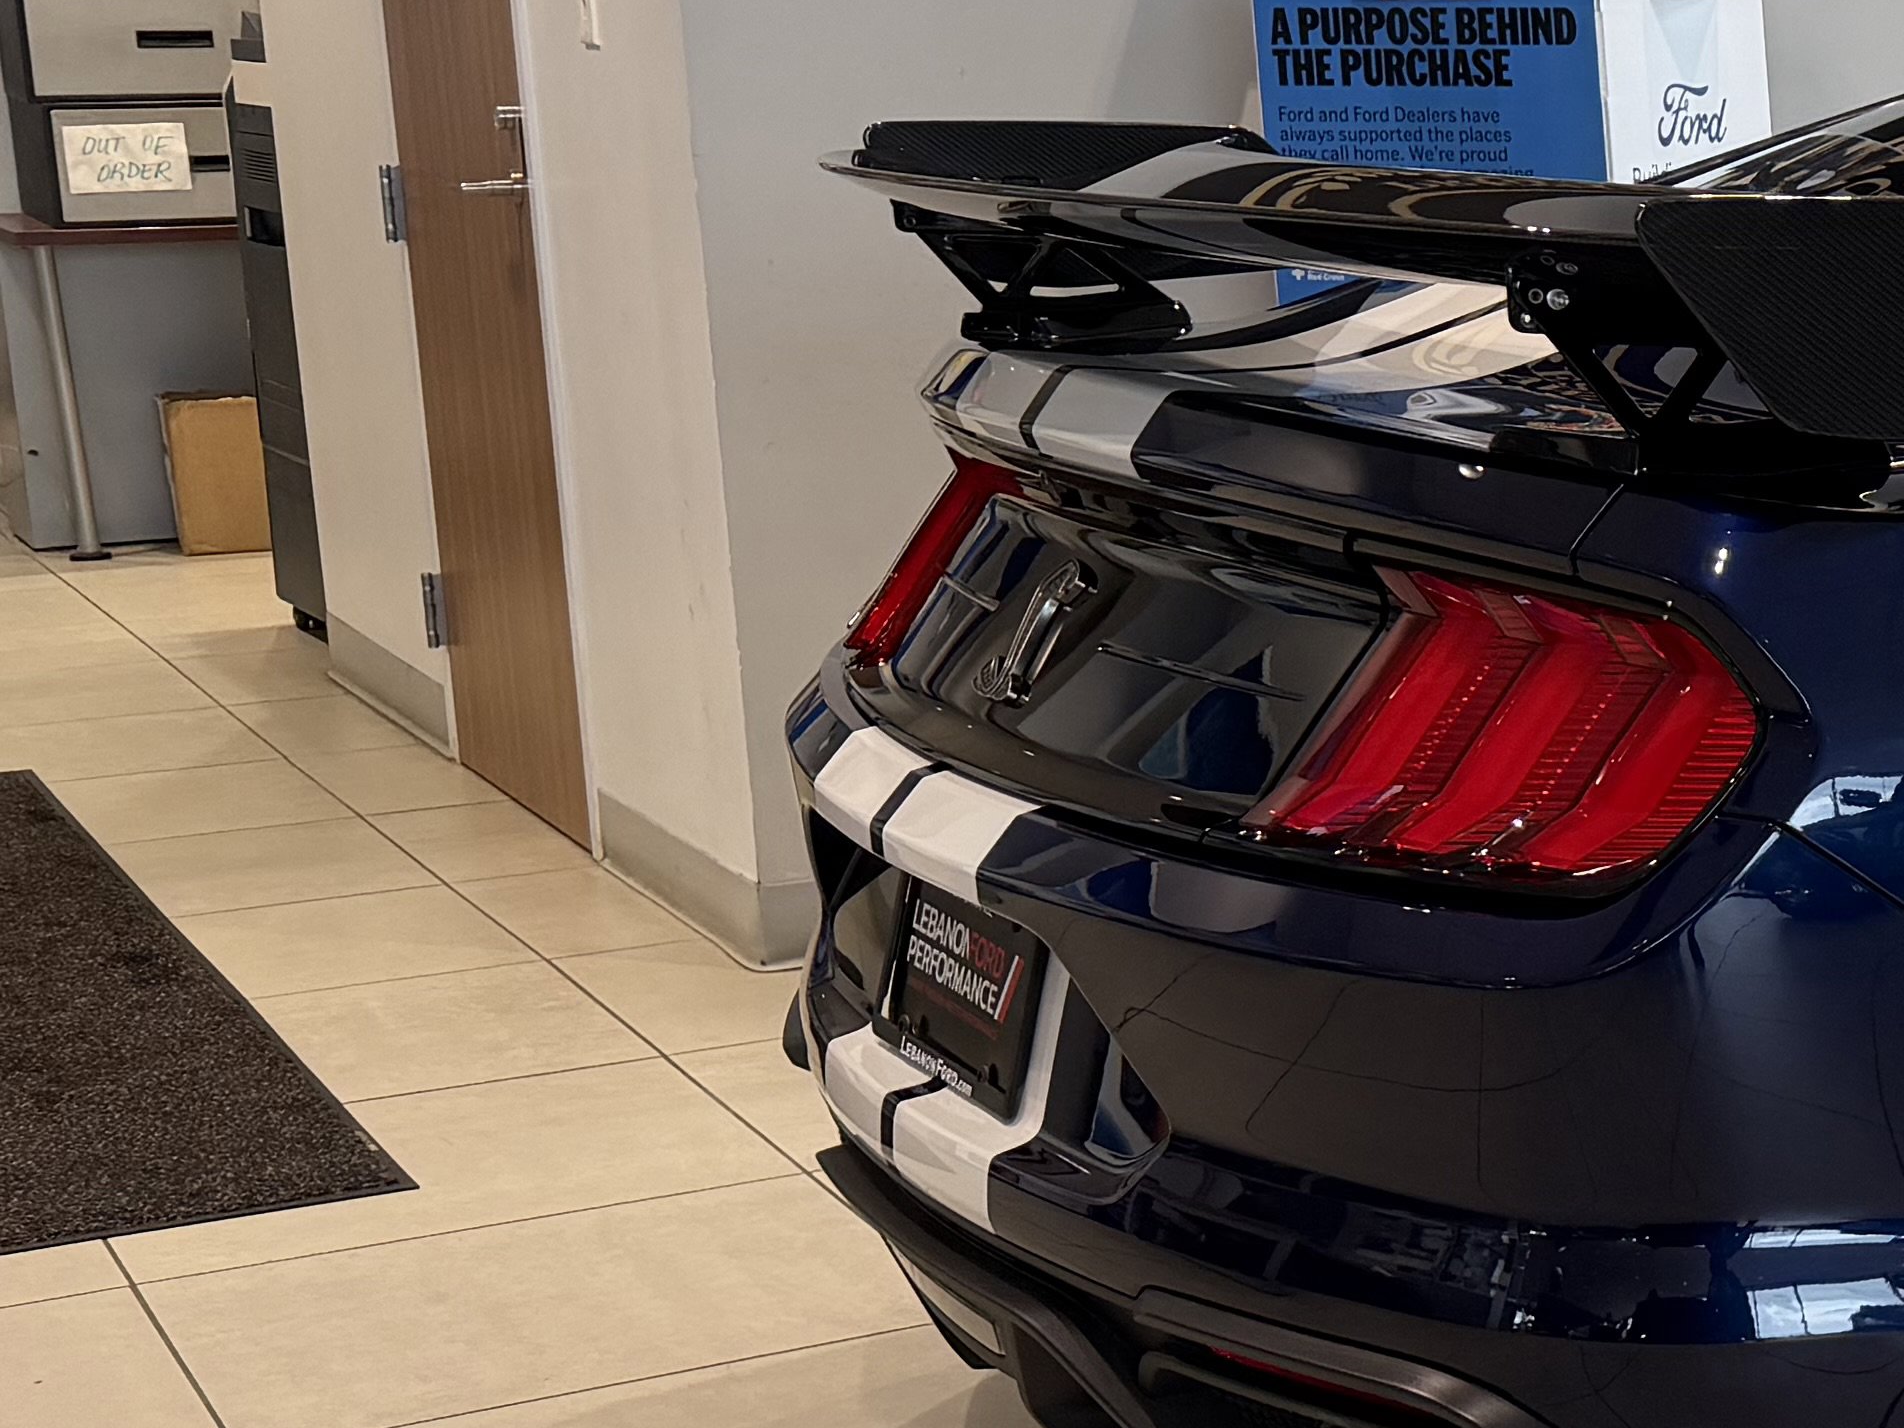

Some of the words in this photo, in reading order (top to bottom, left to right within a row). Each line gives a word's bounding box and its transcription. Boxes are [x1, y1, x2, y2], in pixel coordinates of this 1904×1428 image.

[1270, 7, 1292, 46] A
[1297, 7, 1450, 46] PURPOSE
[1456, 7, 1578, 46] BEHIND
[1272, 48, 1335, 86] THE
[1340, 48, 1513, 86] PURCHASE
[1278, 106, 1314, 123] Ford
[1318, 107, 1348, 123] and
[1354, 106, 1390, 123] Ford
[1394, 106, 1457, 123] Dealers
[1461, 106, 1500, 124] have
[1657, 83, 1728, 148] Ford
[82, 136, 126, 156] OUT
[142, 134, 174, 156] OF
[1280, 126, 1334, 145] always
[1338, 126, 1424, 146] supported
[1428, 127, 1454, 142] the
[1460, 127, 1512, 145] places
[1280, 146, 1317, 160] they
[1321, 145, 1350, 160] call
[1354, 146, 1405, 162] home.
[1408, 146, 1455, 162] We're
[1460, 146, 1508, 164] proud
[96, 160, 173, 183] ORDER
[906, 934, 999, 1015] PERFORMANCE
